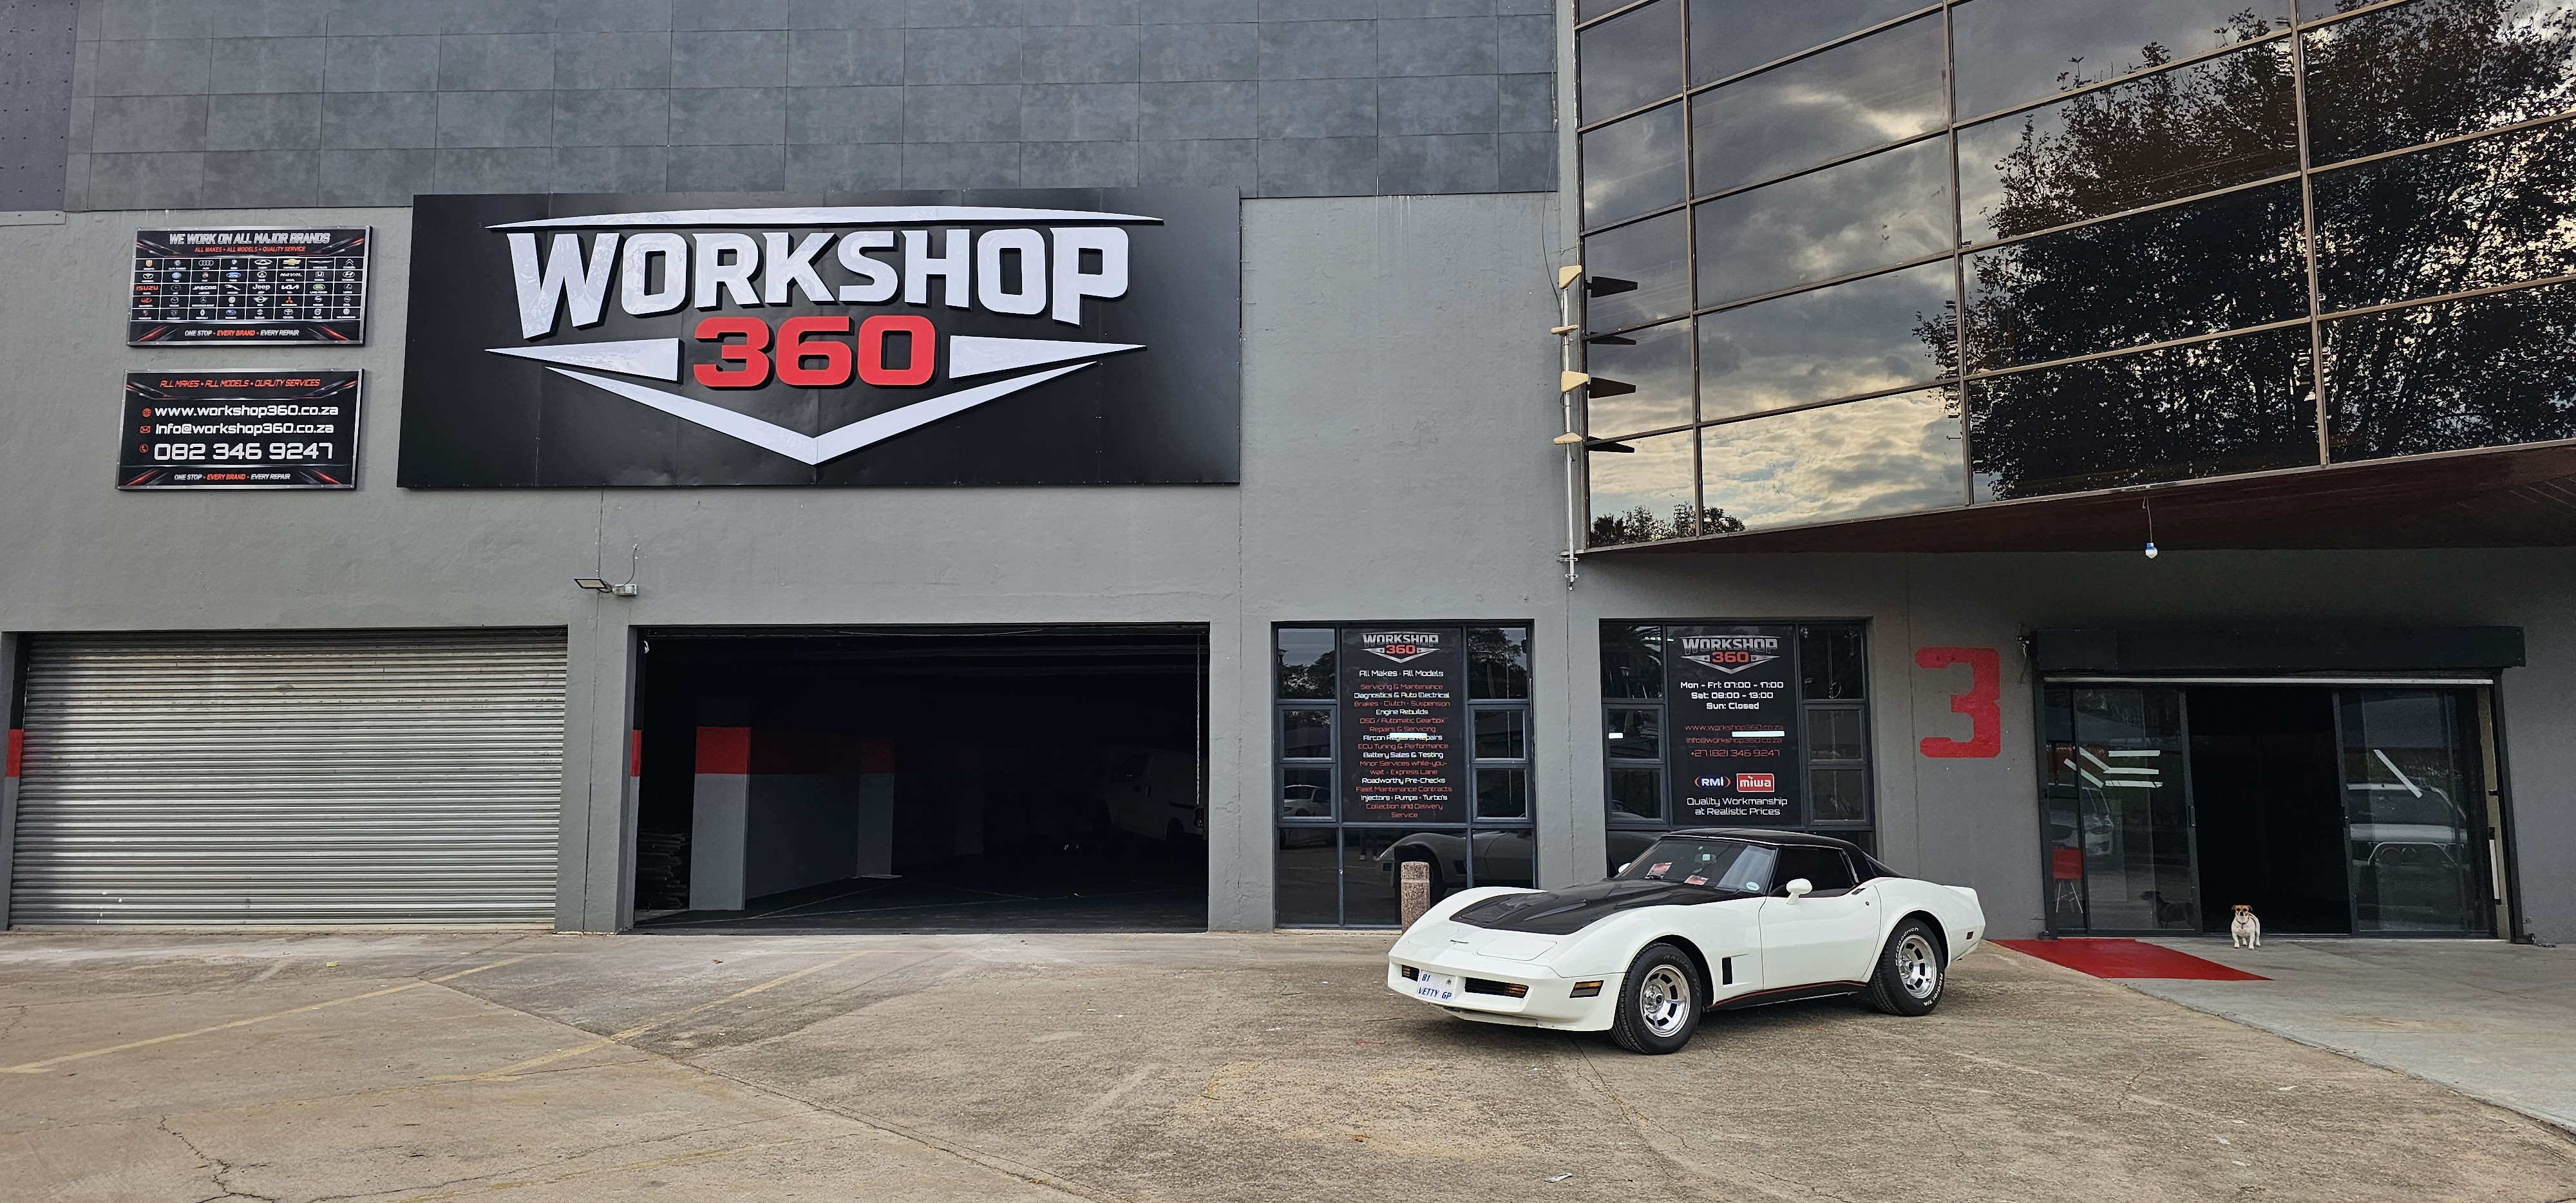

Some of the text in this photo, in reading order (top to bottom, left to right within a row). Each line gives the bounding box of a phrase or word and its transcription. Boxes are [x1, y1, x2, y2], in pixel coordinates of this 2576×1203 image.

[169, 233, 330, 244] WE WORK ON ALL MAJOR BRANDS
[507, 226, 1130, 339] WORKSHOP
[692, 314, 936, 387] 360
[155, 404, 338, 418] www.workshop360.co.za
[155, 442, 333, 460] 082 346 9247
[1363, 634, 1439, 648] WORKSHOP
[1682, 638, 1778, 655] WORKSHOP
[1386, 645, 1416, 654] 360
[1712, 652, 1749, 663] 360
[1915, 647, 2002, 759] 3
[1740, 775, 1771, 787] miwa
[1687, 797, 1788, 806] Quality Workmanship
[1418, 987, 1439, 998] VETTY
